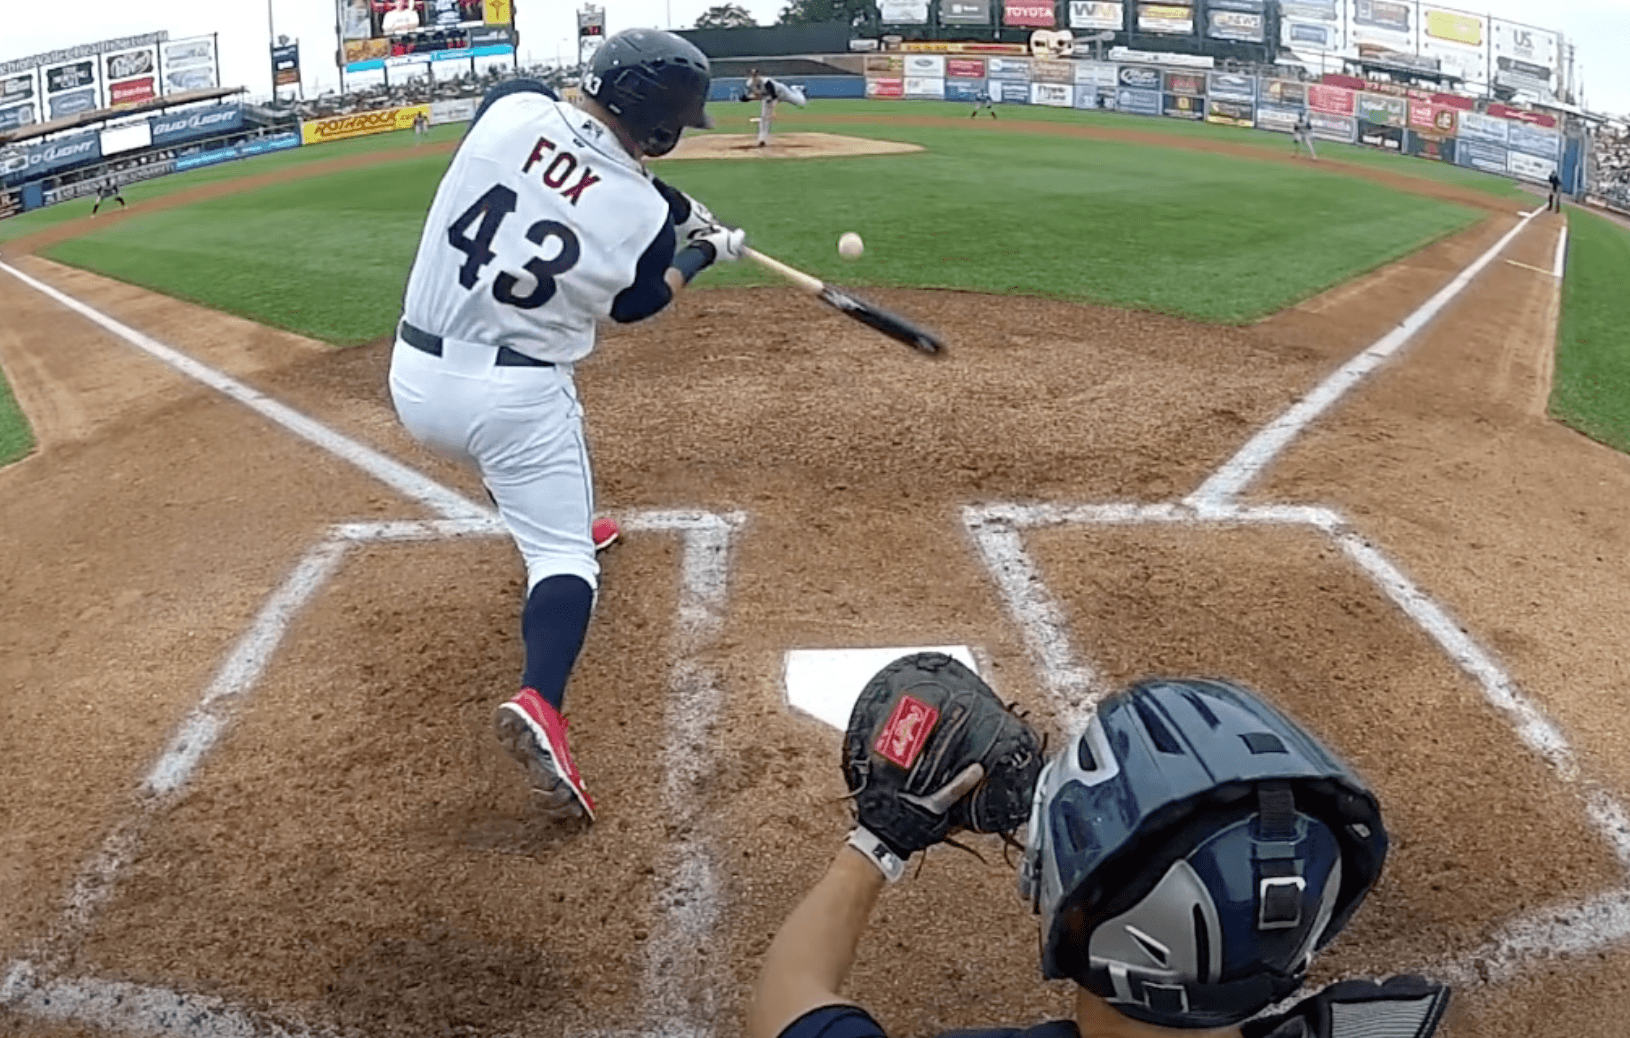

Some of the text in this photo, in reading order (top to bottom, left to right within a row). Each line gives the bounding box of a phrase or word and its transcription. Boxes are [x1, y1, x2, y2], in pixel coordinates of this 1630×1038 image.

[1005, 7, 1054, 18] TOYOTA
[153, 110, 238, 136] BUD LIGHT
[522, 136, 602, 207] FOX
[447, 182, 581, 310] 43
